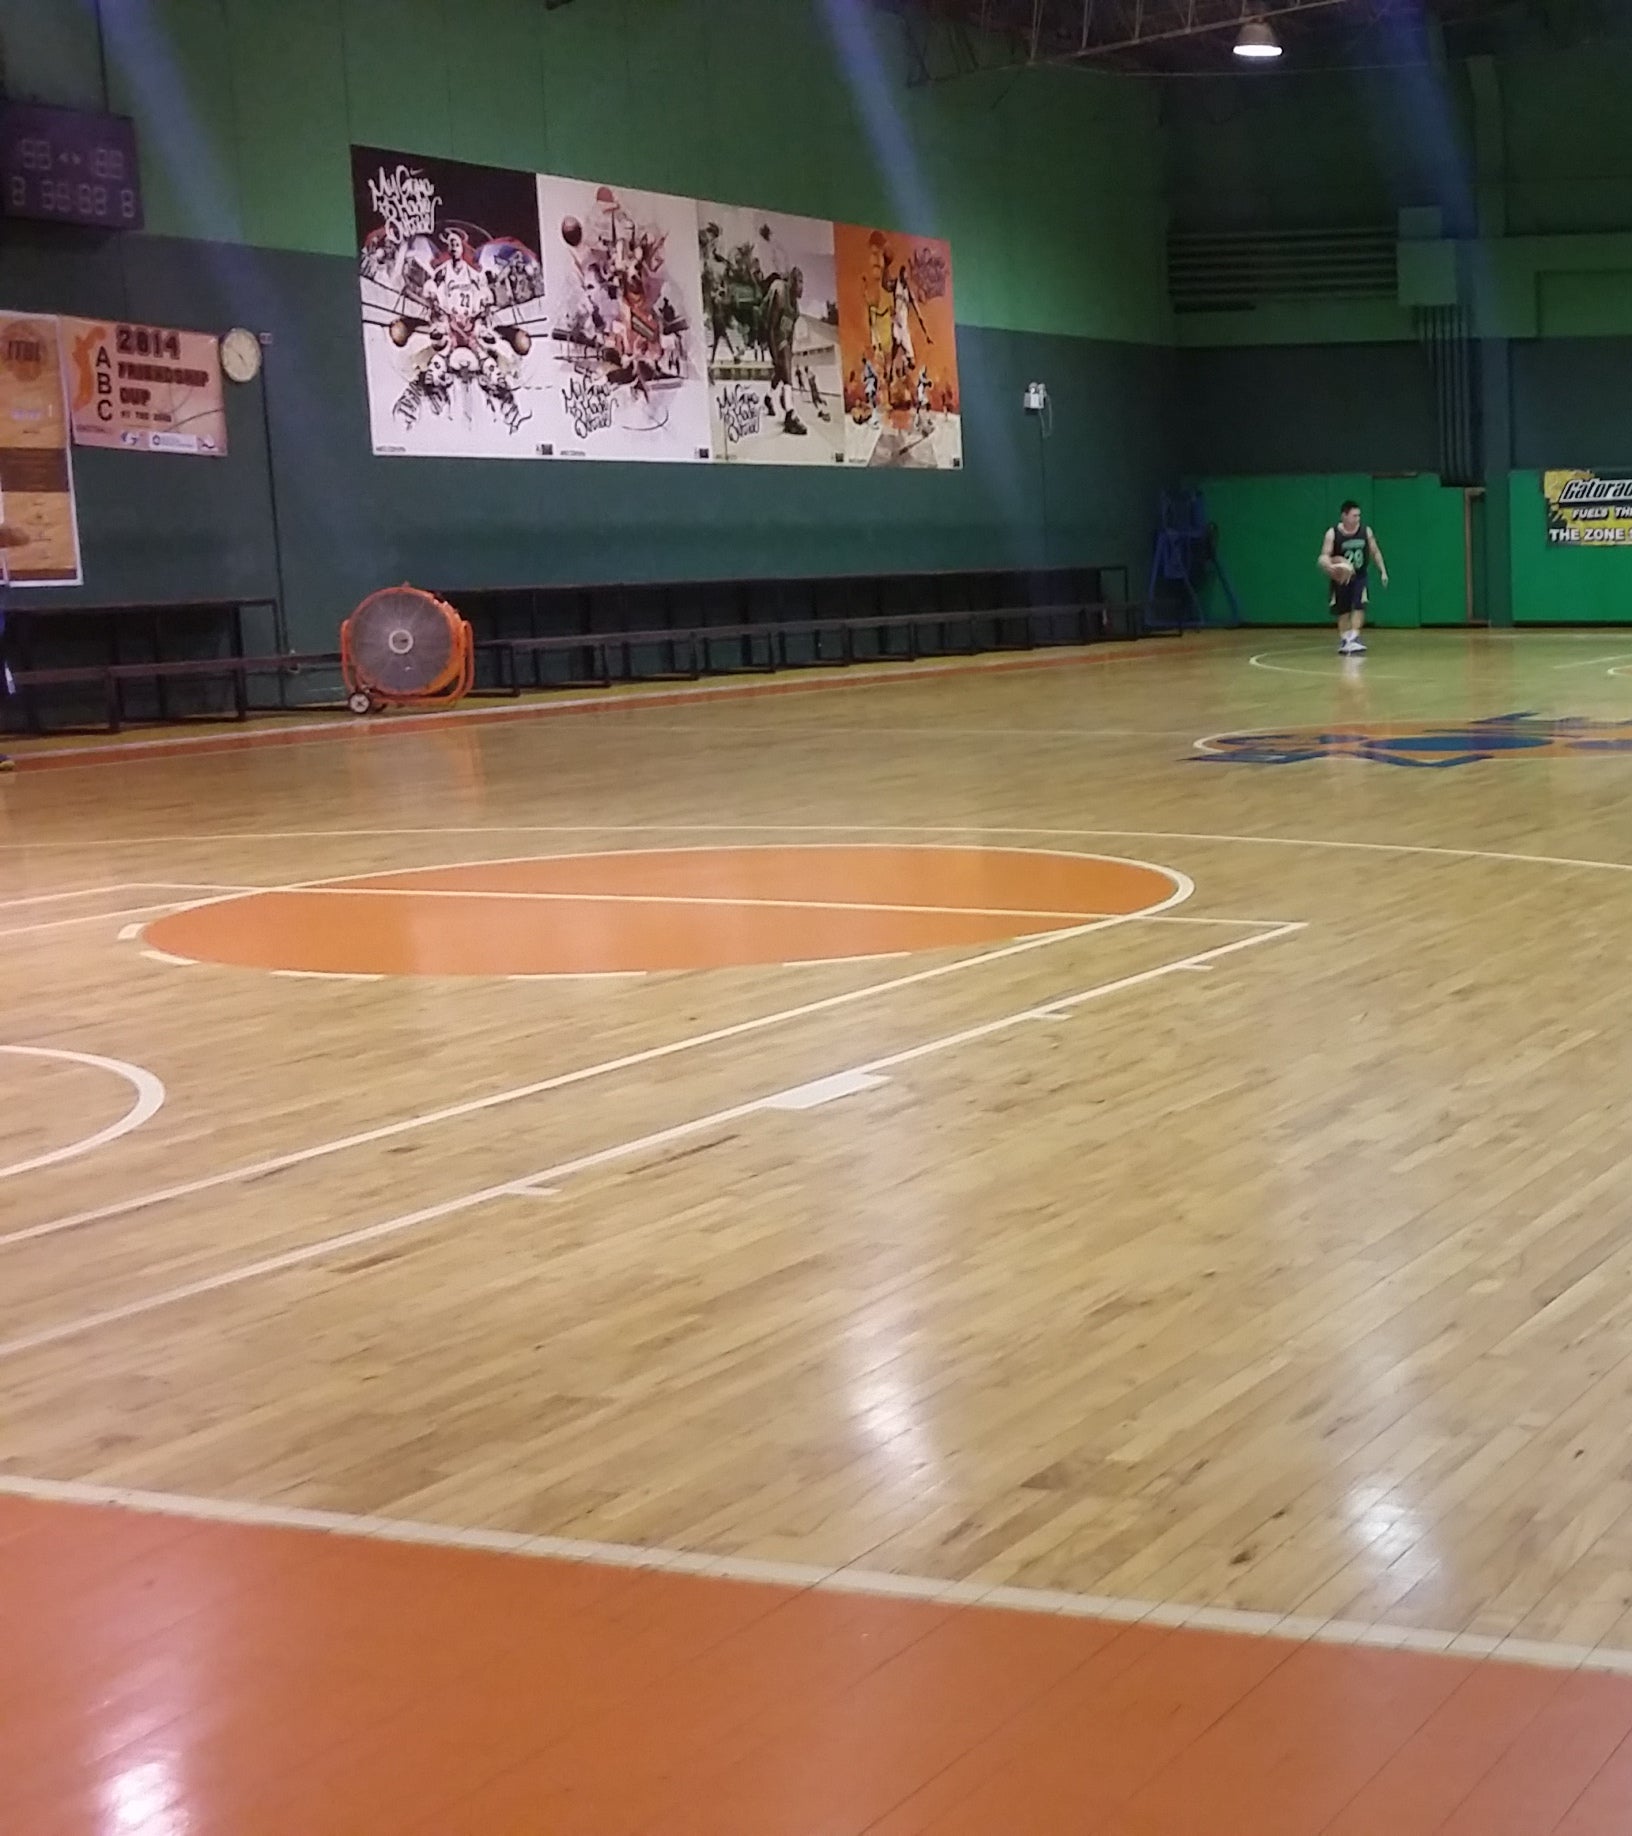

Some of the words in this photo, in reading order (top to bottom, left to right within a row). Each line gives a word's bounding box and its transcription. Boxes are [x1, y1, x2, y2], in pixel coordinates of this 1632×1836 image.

[116, 325, 181, 360] 2014
[1572, 508, 1609, 520] FUELS
[1549, 528, 1580, 541] THE
[1584, 528, 1626, 541] ZONE
